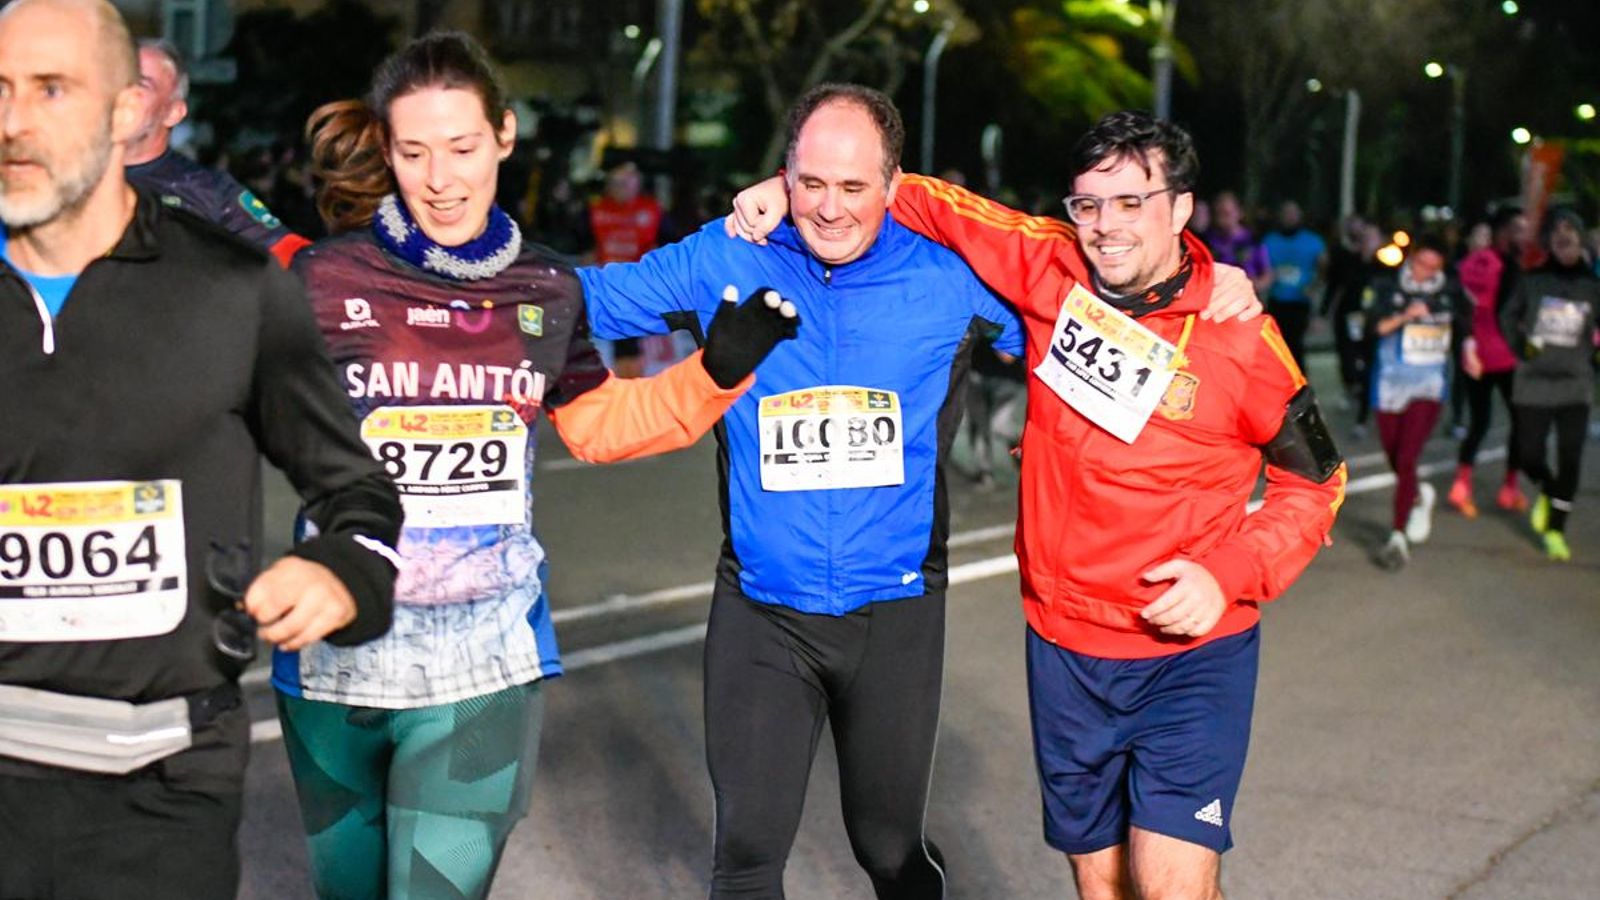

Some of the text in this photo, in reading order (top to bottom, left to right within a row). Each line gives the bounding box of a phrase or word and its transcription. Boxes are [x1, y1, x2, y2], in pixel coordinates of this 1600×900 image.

[1060, 318, 1152, 397] 5431
[346, 362, 419, 398] SAN
[400, 414, 428, 432] 42
[379, 440, 508, 481] 8729
[22, 495, 53, 517] 42
[0, 525, 161, 580] 9064
